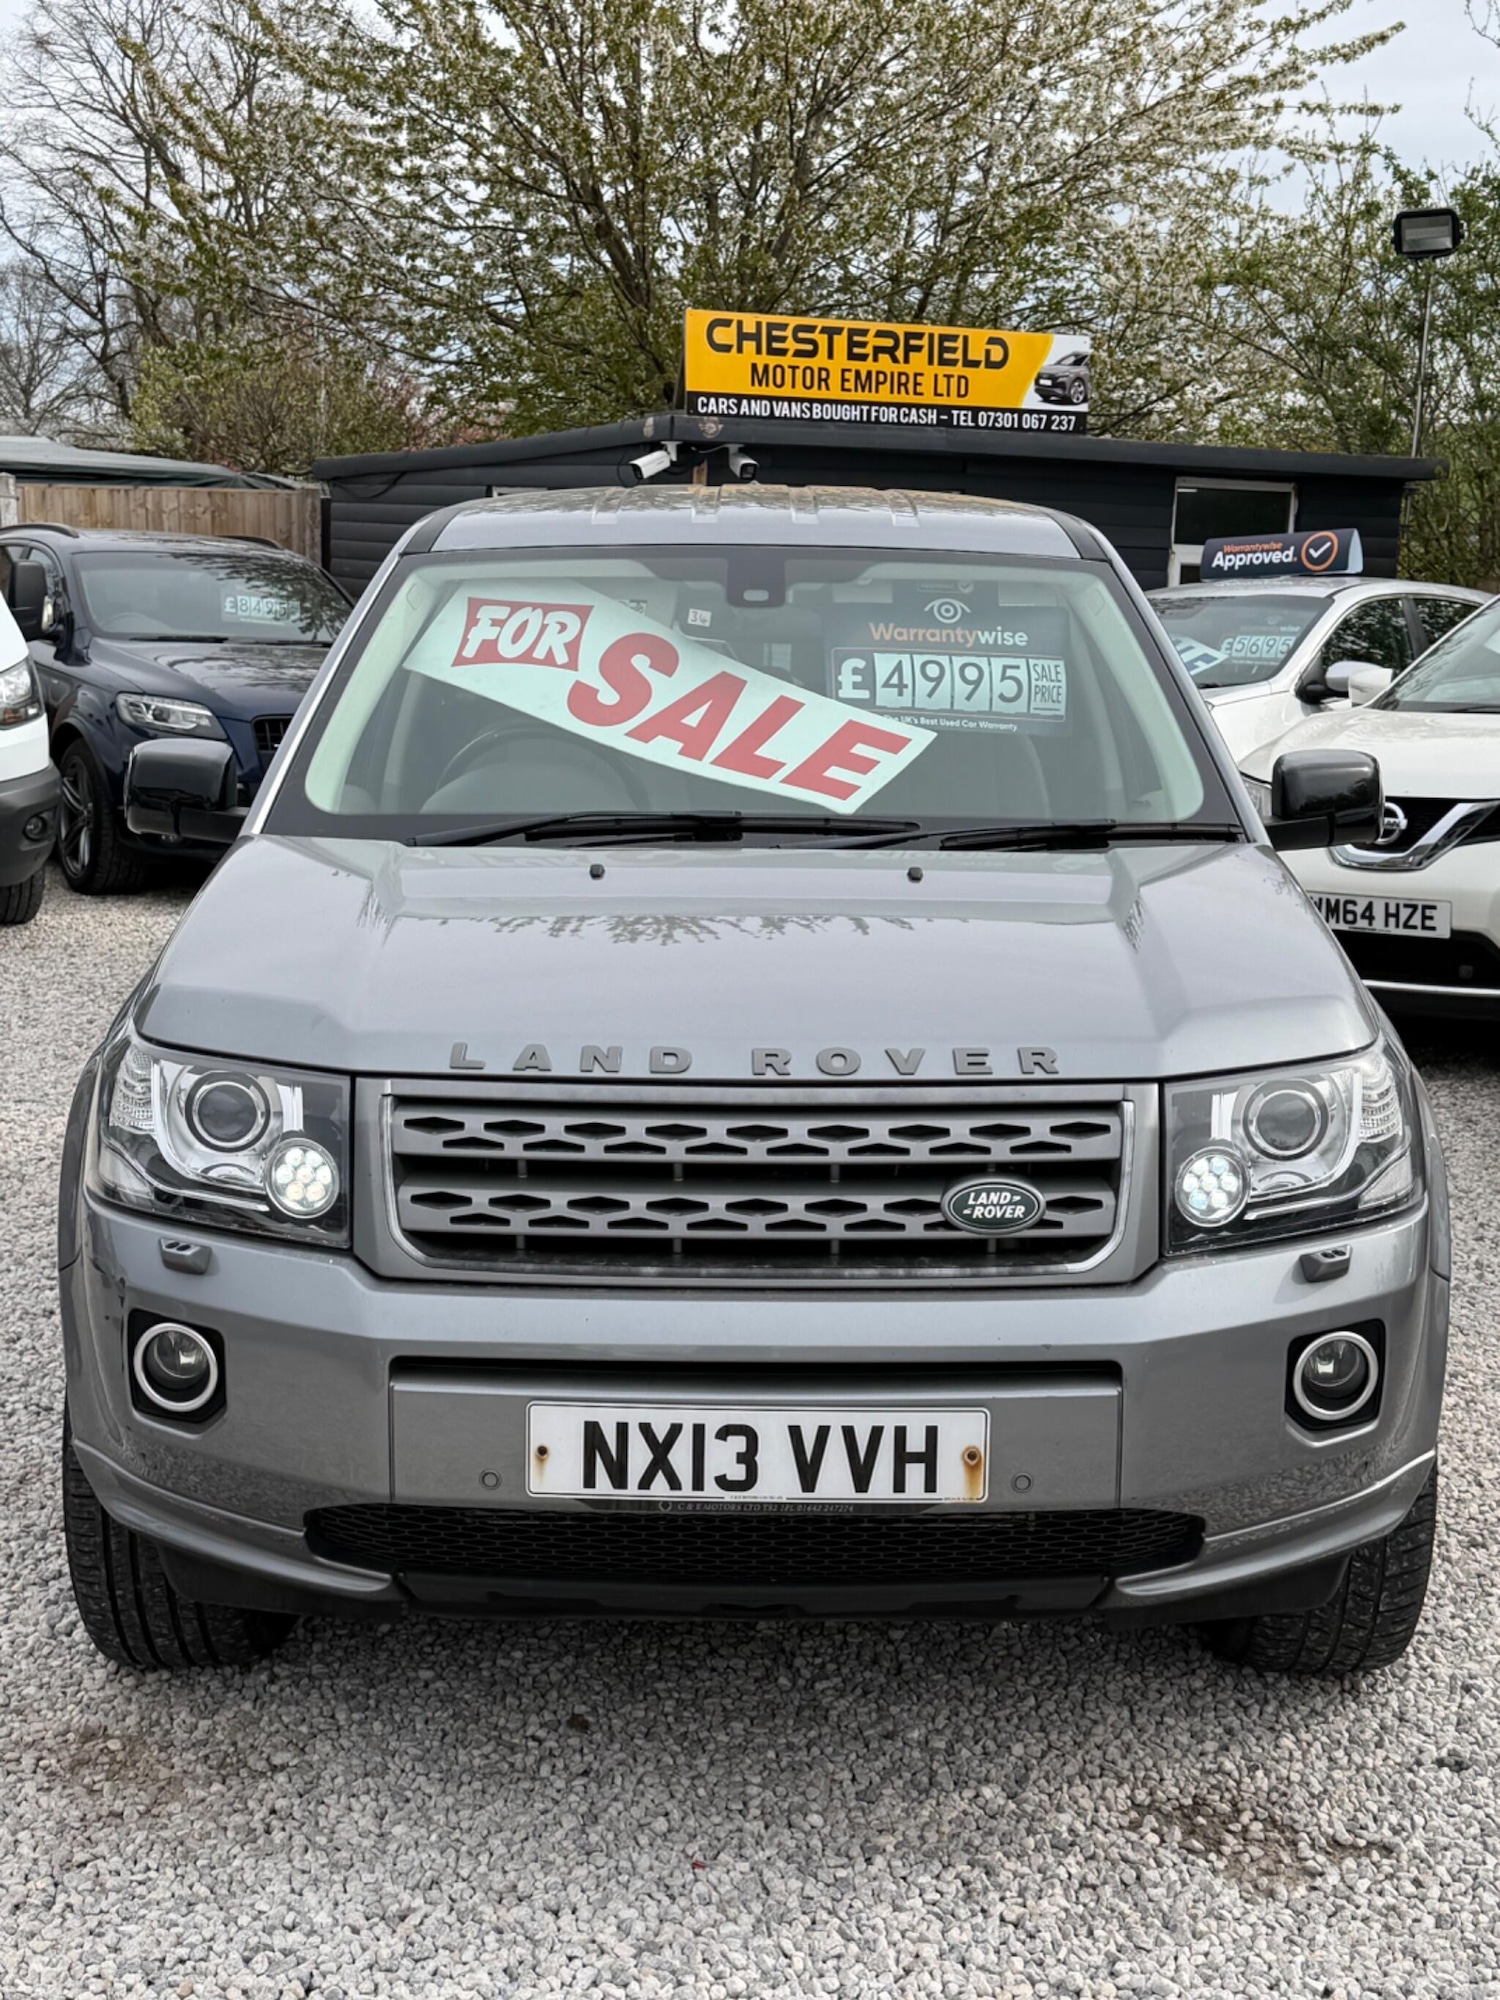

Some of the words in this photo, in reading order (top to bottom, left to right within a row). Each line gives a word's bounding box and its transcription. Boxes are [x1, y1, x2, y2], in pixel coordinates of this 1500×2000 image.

[706, 318, 1009, 370] CHESTERFIELD
[751, 362, 830, 391] MOTOR
[840, 368, 924, 396] EMPIRE
[933, 373, 969, 398] LTD
[697, 396, 738, 415] CARS
[739, 399, 771, 417] AND
[772, 400, 811, 419] VANS
[812, 402, 870, 422] BOUGHT
[871, 405, 899, 424] FOR
[900, 406, 937, 425] CASH
[951, 410, 976, 426] TEL
[978, 411, 1019, 428] 07301
[1022, 413, 1048, 430] 067
[1051, 415, 1077, 431] 237
[1211, 546, 1298, 571] Approved.
[1223, 542, 1284, 554] Warrantywise
[224, 596, 287, 616] £8495
[462, 604, 582, 665] FOR
[869, 622, 1028, 648] Warrantywise
[838, 657, 1024, 703] £4995
[1032, 663, 1062, 683] SALE
[1033, 684, 1062, 704] PRICE
[567, 632, 912, 801] SALE
[920, 716, 938, 726] Best
[939, 718, 960, 727] Used
[962, 720, 977, 728] Car
[979, 721, 1018, 732] Warranty
[1385, 903, 1438, 932] HZE
[449, 1043, 692, 1074] LAND
[752, 1047, 1060, 1076] ROVER
[968, 1191, 1012, 1205] LAND
[972, 1205, 1026, 1219] ROVER
[583, 1420, 759, 1492] NX13
[788, 1425, 938, 1493] VVH
[703, 1503, 741, 1511] MOTORS
